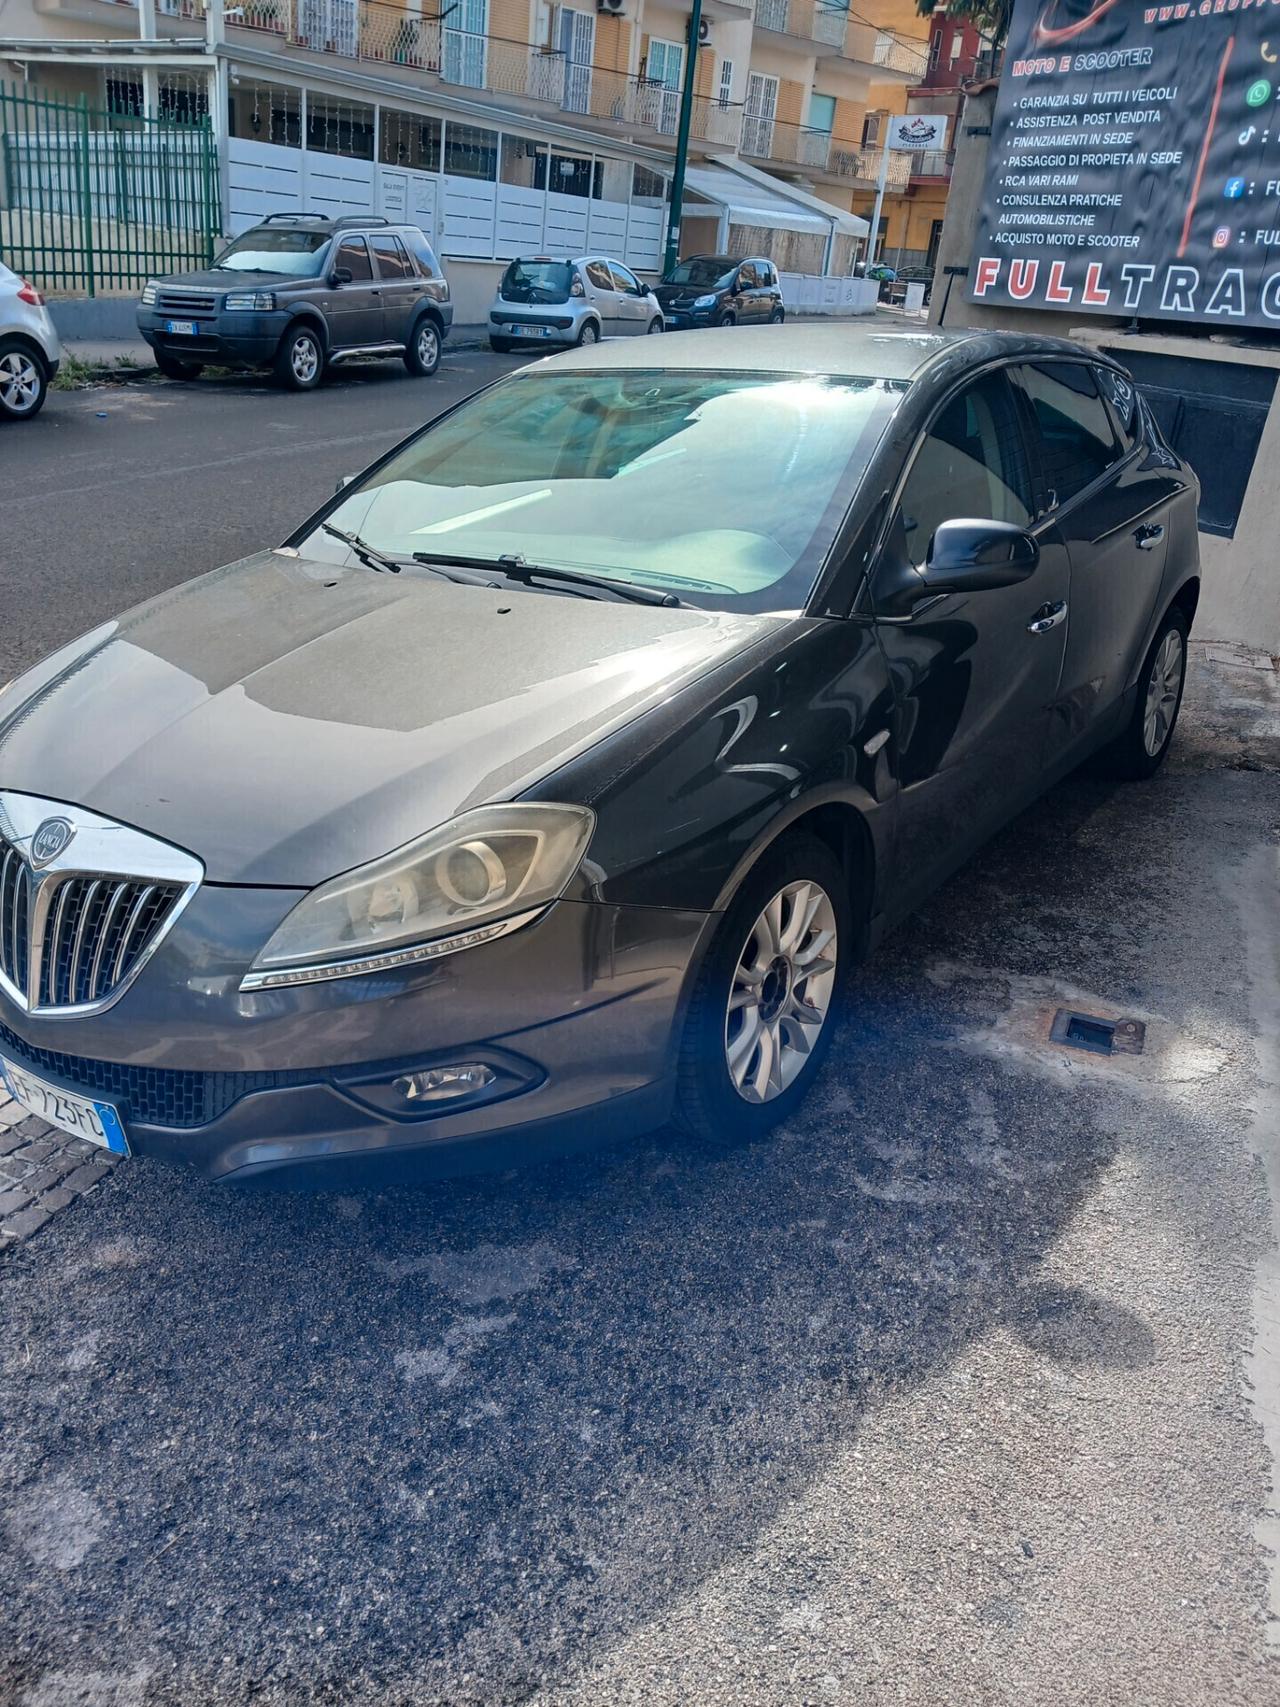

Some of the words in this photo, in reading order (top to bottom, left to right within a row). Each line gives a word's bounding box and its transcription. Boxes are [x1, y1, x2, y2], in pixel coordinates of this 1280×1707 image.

[1144, 0, 1280, 23] WWW.GRUP
[1012, 58, 1055, 76] MOTO
[1059, 56, 1071, 72] E
[1074, 47, 1153, 71] SCOOTER
[1020, 94, 1070, 109] GARANZIA
[1072, 93, 1087, 105] SU
[1092, 91, 1122, 104] TUTTI
[1125, 90, 1130, 102] I
[1131, 87, 1177, 101] VEICOLI
[1016, 114, 1077, 128] ASSISTENZA
[1083, 112, 1112, 126] POST
[1114, 110, 1160, 124] VENDITA
[1012, 134, 1088, 148] FINANZIAMENTI
[1089, 133, 1101, 145] IN
[1103, 132, 1134, 144] SEDE
[1008, 154, 1066, 167] PASSAGGIO
[1069, 154, 1079, 166] DI
[1081, 153, 1134, 166] PROPIETA
[1136, 152, 1148, 165] IN
[1150, 151, 1182, 164] SEDE
[1004, 175, 1025, 186] RCA
[1028, 175, 1050, 186] VARI
[1052, 174, 1079, 186] RAMI
[1002, 194, 1067, 206] CONSULENZA
[1069, 194, 1122, 206] PRATICHE
[998, 213, 1096, 226] AUTOMOBILISTICHE
[994, 232, 1045, 246] ACQUISTO
[1046, 234, 1075, 245] MOTO
[1077, 234, 1085, 246] E
[1087, 234, 1140, 248] SCOOTER
